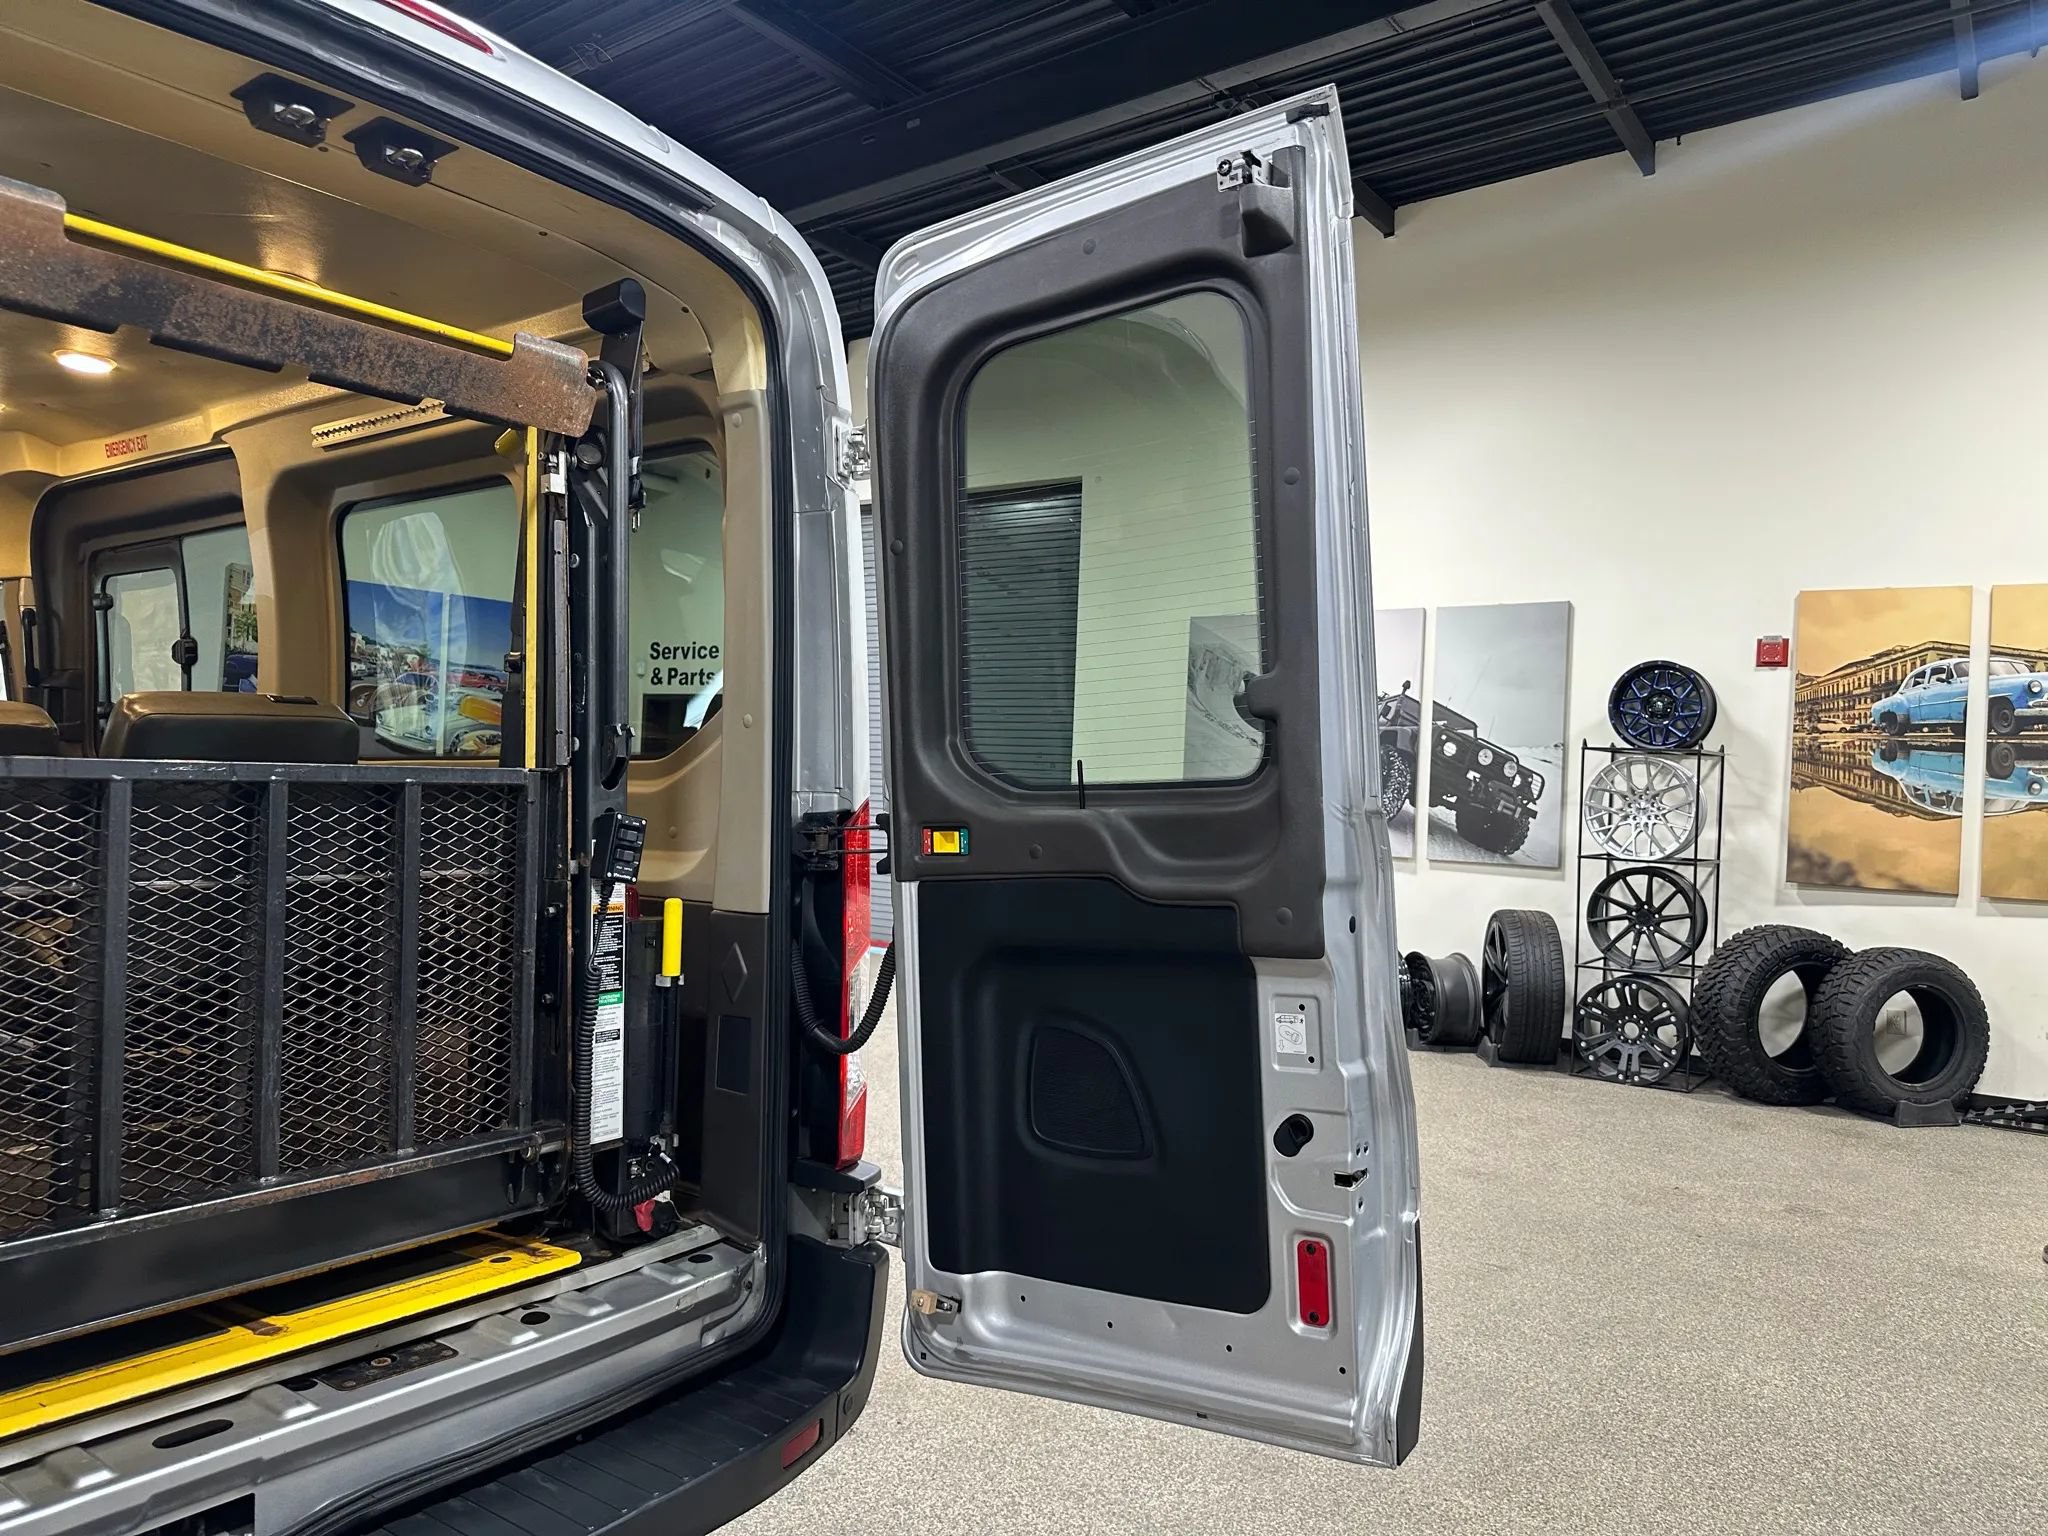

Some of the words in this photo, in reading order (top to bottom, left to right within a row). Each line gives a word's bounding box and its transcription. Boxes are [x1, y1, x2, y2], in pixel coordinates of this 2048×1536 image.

[105, 438, 136, 458] EMERGENCY
[136, 435, 148, 451] EXIT
[649, 641, 720, 660] Service
[650, 667, 663, 686] &
